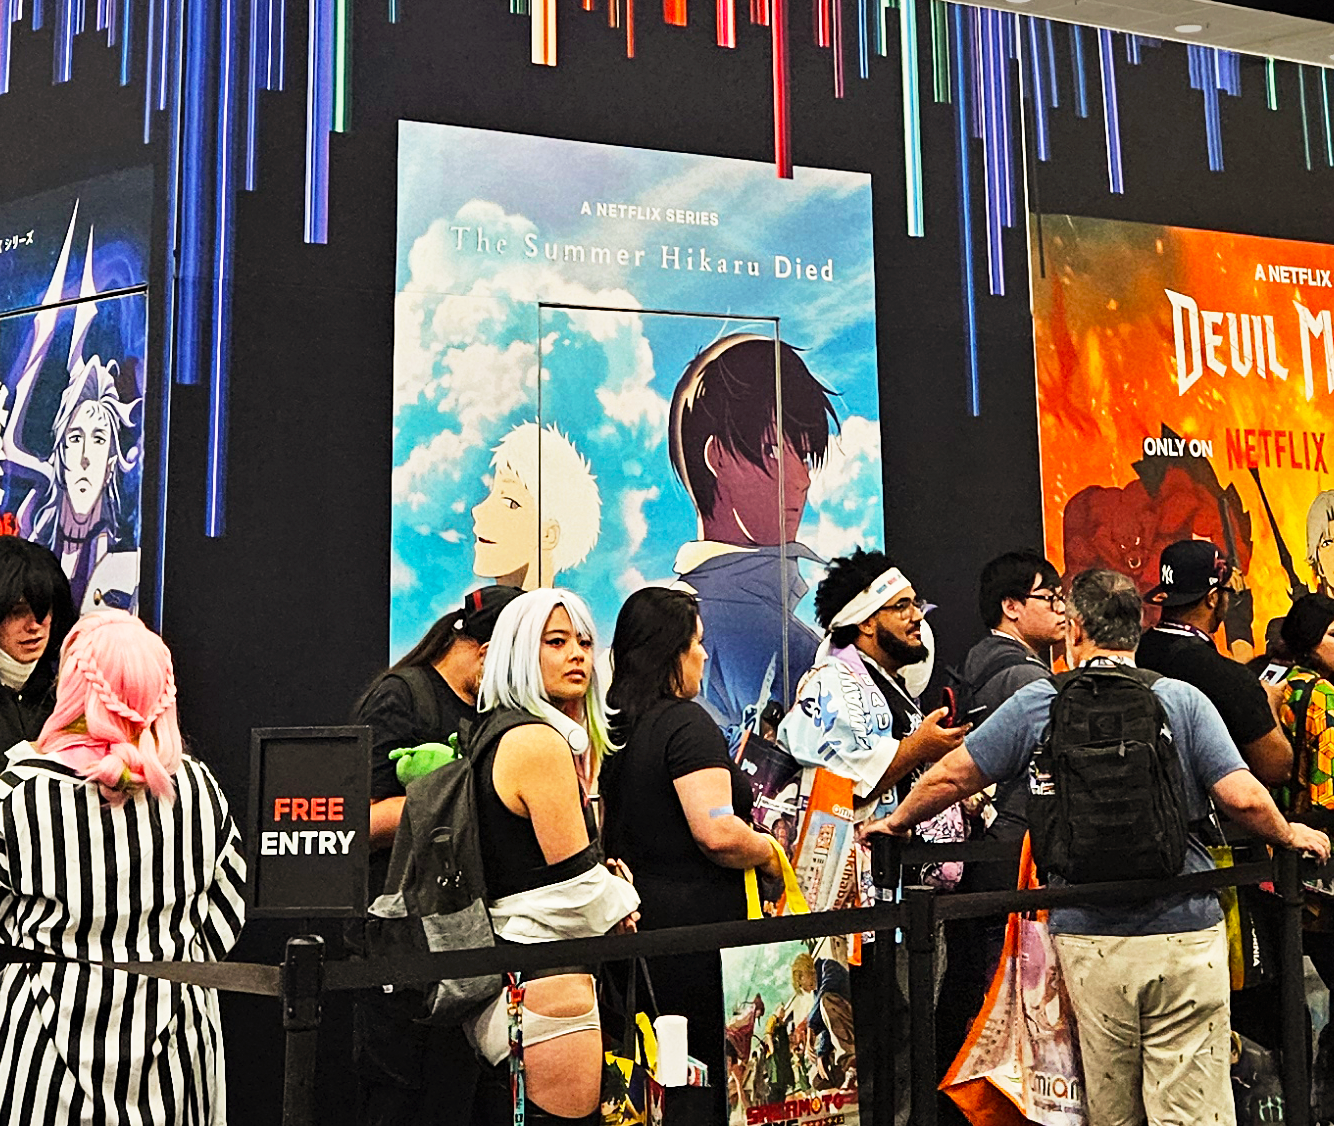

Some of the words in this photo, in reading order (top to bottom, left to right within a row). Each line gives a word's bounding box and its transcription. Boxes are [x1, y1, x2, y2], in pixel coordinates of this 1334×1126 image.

[581, 201, 593, 215] A
[596, 202, 661, 222] NETFLIX
[665, 209, 719, 226] SERIES
[5, 229, 34, 252] シリーズ
[450, 226, 507, 255] The
[524, 233, 646, 268] Summer
[661, 245, 760, 277] Hikaru
[774, 255, 834, 282] Died
[1254, 264, 1266, 281] A
[1268, 265, 1331, 288] NETFLIX
[1143, 437, 1188, 457] ONLY
[1189, 439, 1213, 458] ON
[1225, 427, 1328, 474] NETFLIX
[274, 797, 344, 821] FREE
[261, 830, 356, 855] ENTRY
